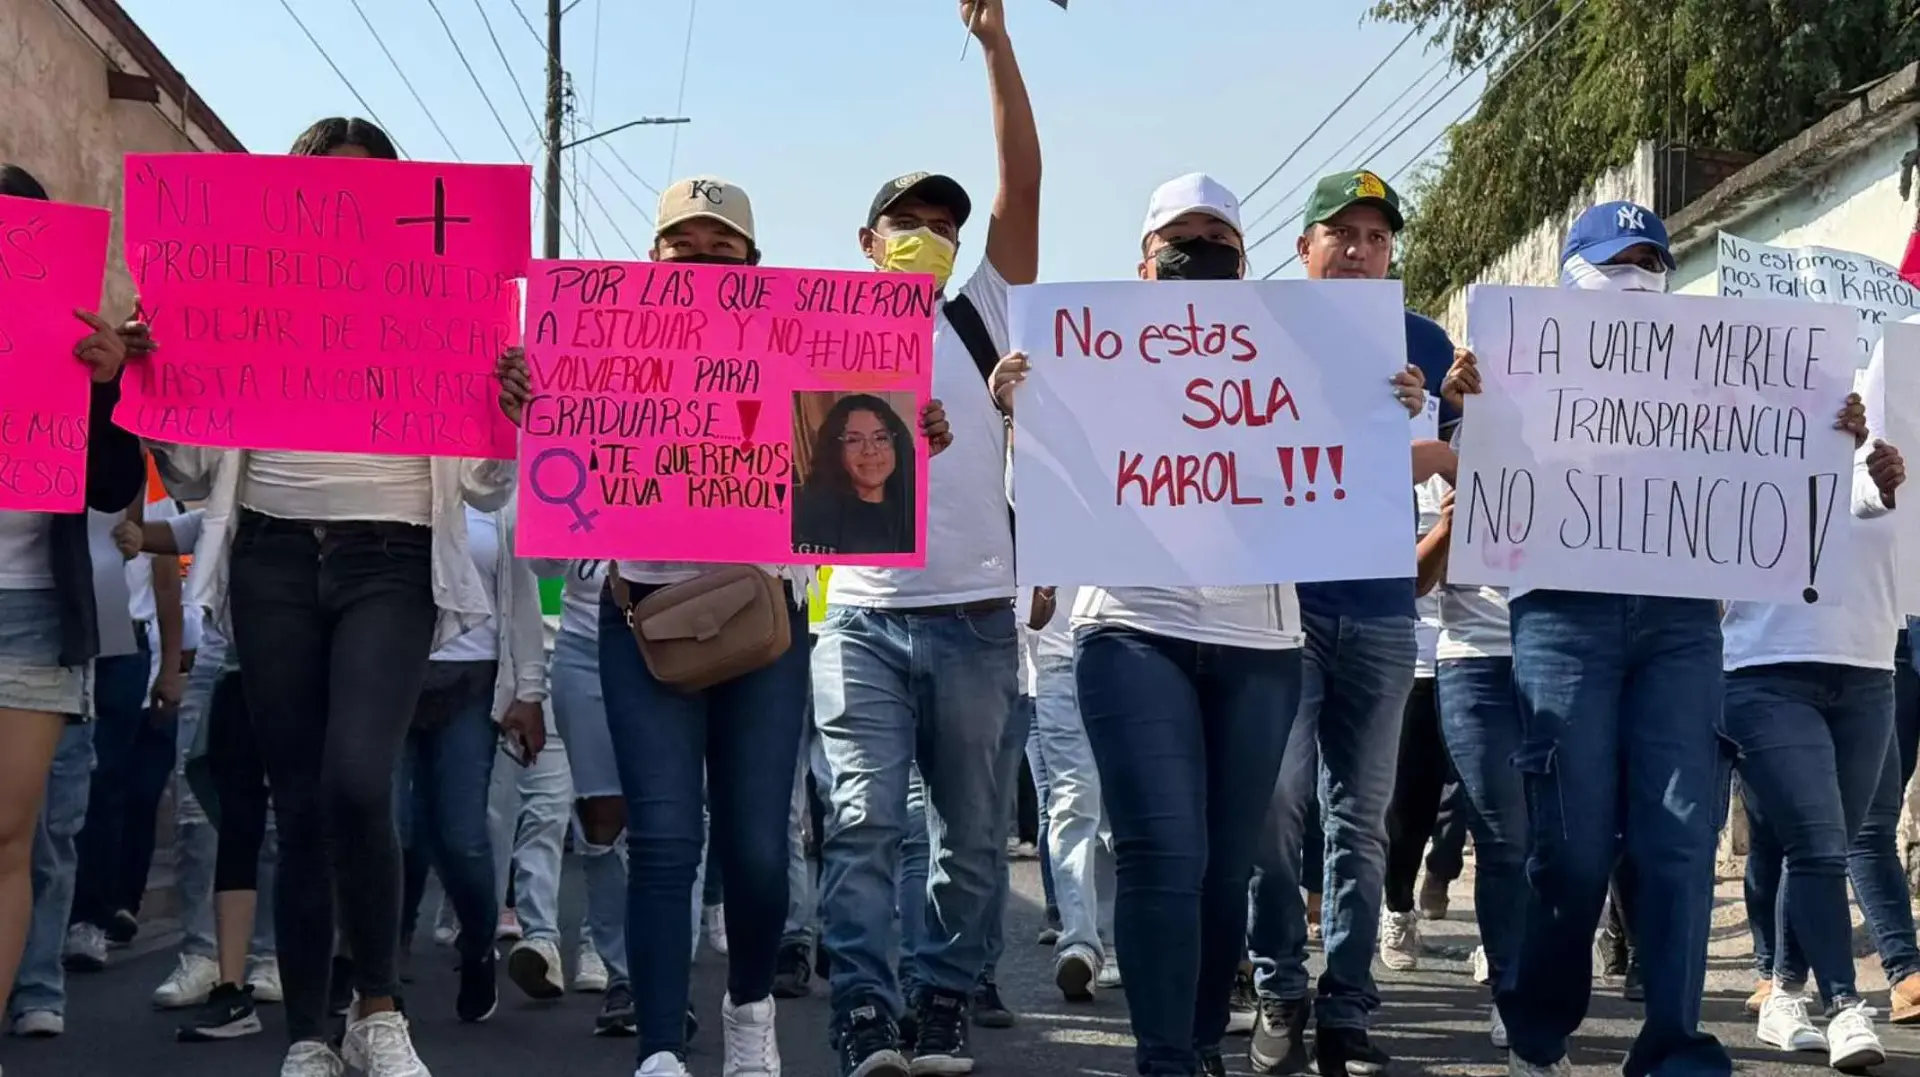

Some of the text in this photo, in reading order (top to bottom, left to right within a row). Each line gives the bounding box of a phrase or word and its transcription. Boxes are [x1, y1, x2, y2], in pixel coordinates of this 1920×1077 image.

[262, 186, 366, 241] UNA
[689, 180, 723, 205] KC
[1616, 205, 1646, 230] NY
[139, 239, 367, 291] PROHIBIDO
[1720, 237, 1750, 263] No
[1758, 252, 1859, 273] estamos
[546, 265, 934, 319] POR LAS QUE SALIERON
[1721, 264, 1760, 288] nos
[1841, 273, 1920, 310] KAROL
[184, 306, 302, 346] DEJAR
[321, 313, 358, 352] DE
[381, 314, 511, 360] BUSCAR
[536, 307, 803, 357] A ESTUDIAR Y NO
[805, 330, 920, 375] #UAEM
[1055, 303, 1258, 364] No estas
[1506, 296, 1827, 392] LA UAEM MERECE
[140, 361, 259, 400] HASTA
[531, 353, 761, 394] VOLVIERON PARA
[137, 403, 235, 440] UAEM
[1182, 376, 1300, 430] SOLA
[1547, 387, 1807, 460] TRANSPARENCIA
[2, 410, 87, 452] EMOS
[655, 442, 790, 477] QUEREMOS
[599, 475, 787, 515] VIVA KAROL!
[1466, 466, 1535, 545] NO
